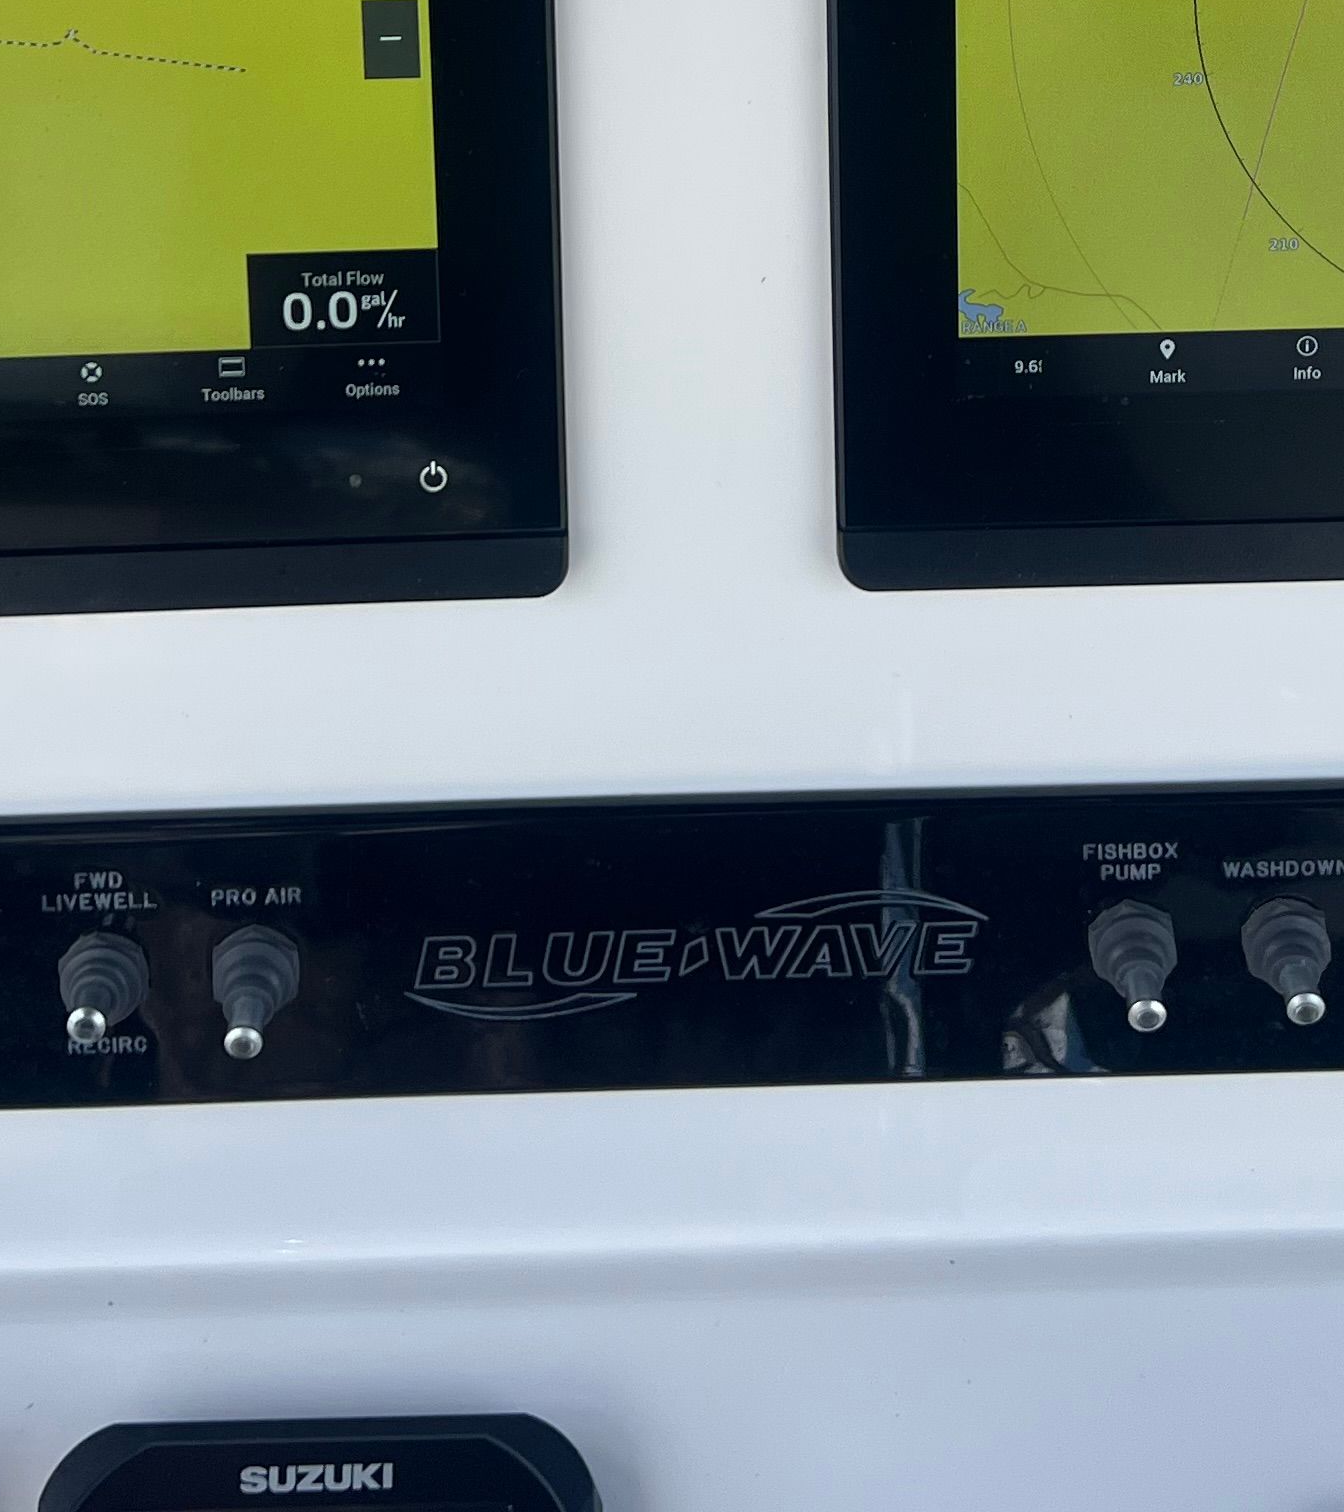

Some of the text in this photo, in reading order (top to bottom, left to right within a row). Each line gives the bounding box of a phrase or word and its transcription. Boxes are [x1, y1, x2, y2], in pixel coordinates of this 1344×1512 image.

[1172, 72, 1205, 87] 240
[1268, 237, 1301, 252] 210
[301, 269, 385, 288] Total Flow
[282, 290, 357, 332] 0.0
[1149, 368, 1187, 384] Mark
[1293, 365, 1322, 381] Info
[77, 391, 109, 407] SOS
[200, 385, 266, 403] Toolbars
[344, 380, 401, 400] Options
[1082, 841, 1179, 861] FISHBOX
[73, 871, 124, 891] FWD
[1099, 862, 1162, 882] PUMP
[40, 890, 158, 913] LIVEWELL
[210, 886, 303, 908] PRO AIR
[412, 920, 981, 990] BLUE WAVE
[66, 1036, 149, 1056] RECIRC
[239, 1462, 394, 1494] SUZUKI
